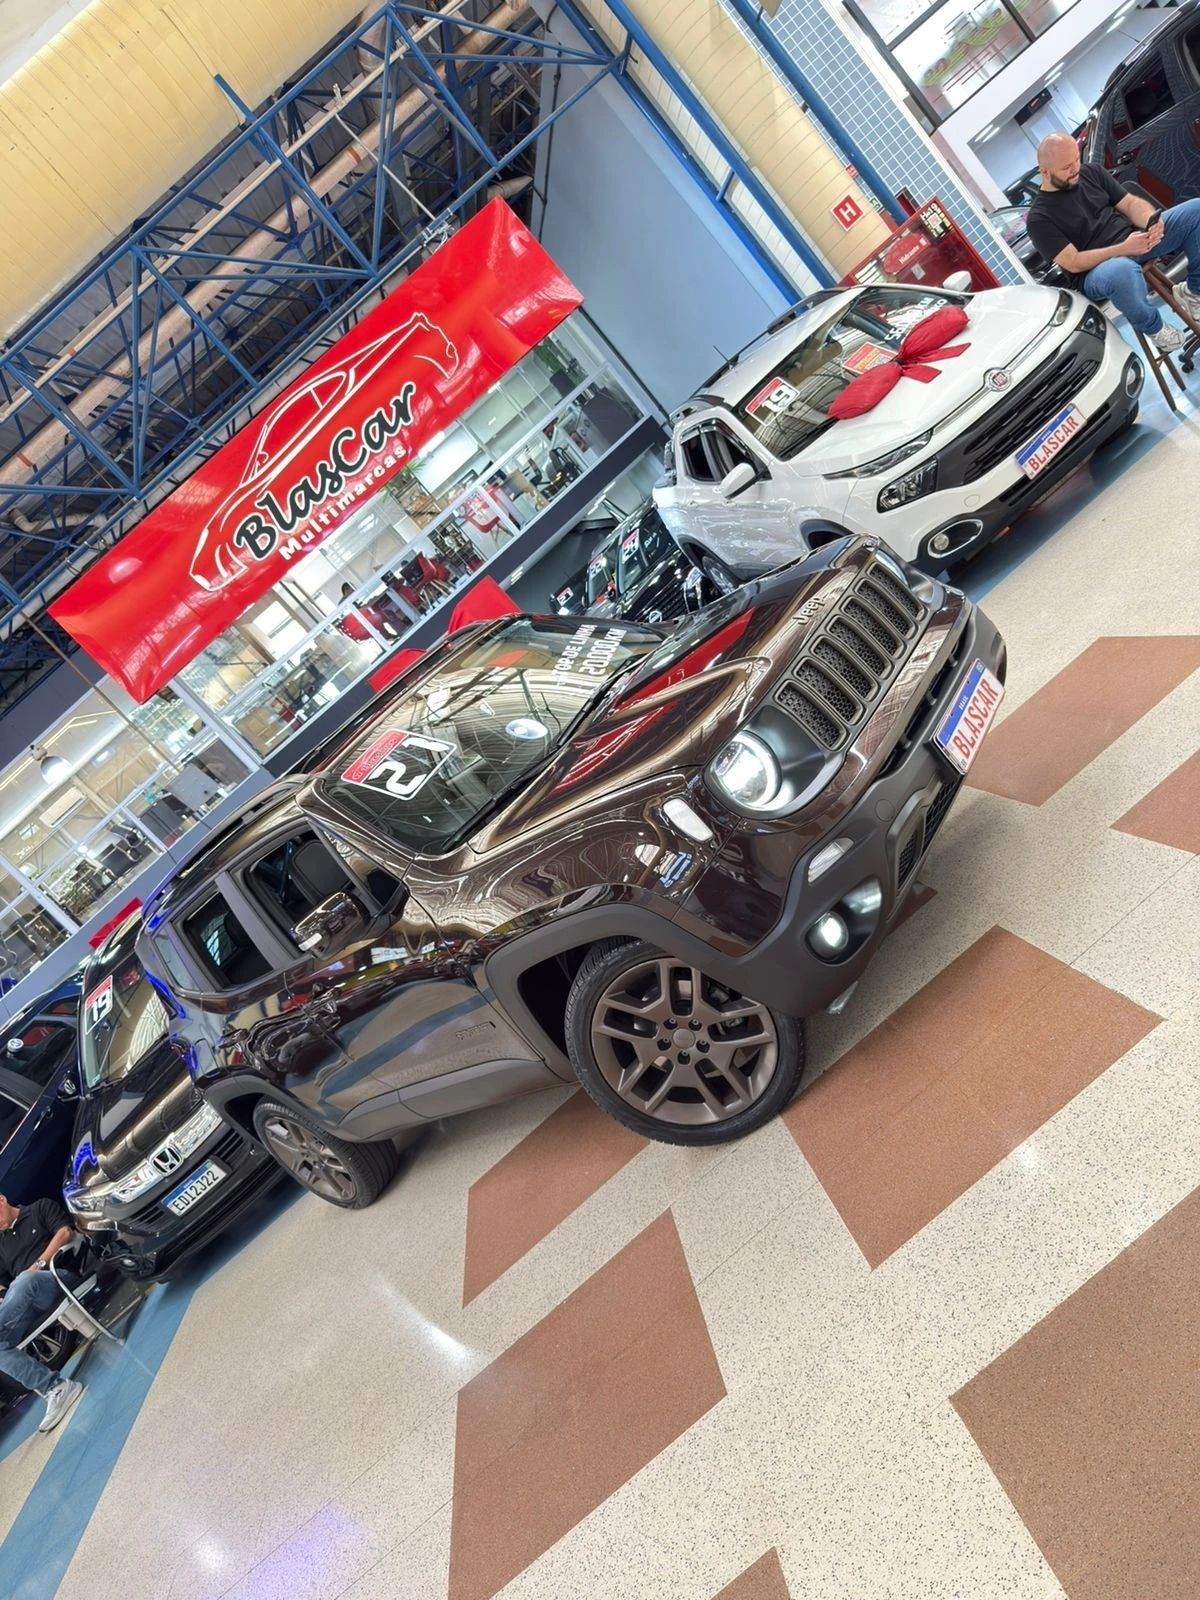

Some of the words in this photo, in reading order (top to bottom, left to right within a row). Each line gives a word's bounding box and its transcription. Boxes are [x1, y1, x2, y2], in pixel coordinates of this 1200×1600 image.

[760, 384, 797, 414] 19
[234, 381, 416, 561] BlasCar
[1028, 415, 1079, 472] BLASCAR
[279, 444, 407, 561] Multimarcas
[792, 597, 825, 625] Jeep
[953, 679, 999, 759] BLASCAR
[368, 737, 450, 795] 21
[91, 989, 112, 1021] 19
